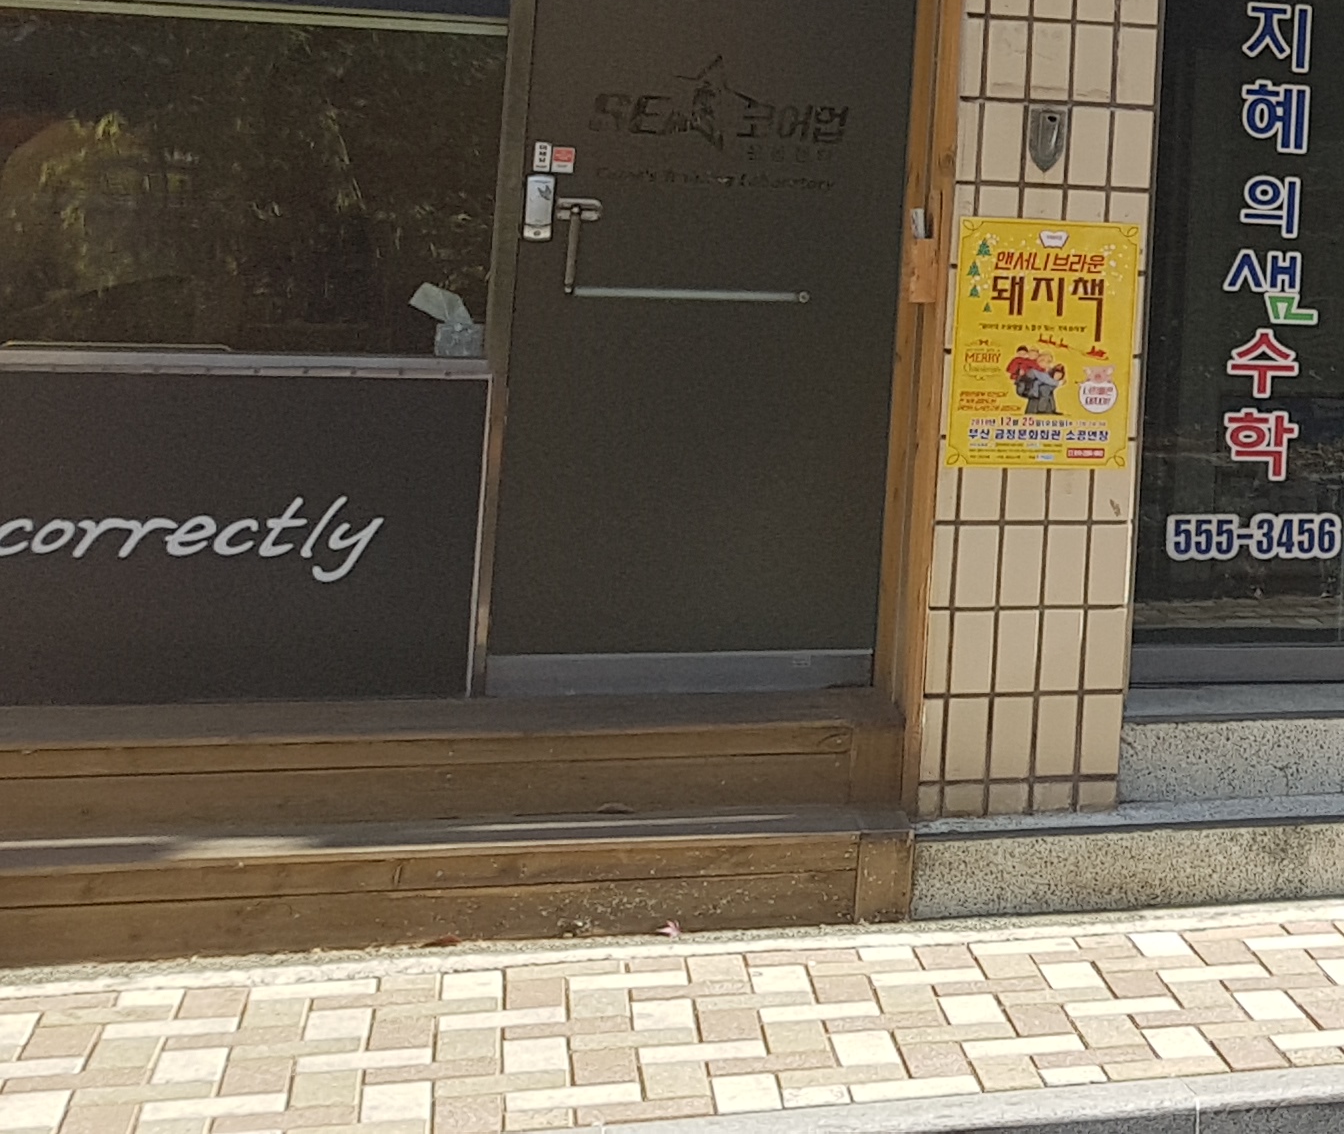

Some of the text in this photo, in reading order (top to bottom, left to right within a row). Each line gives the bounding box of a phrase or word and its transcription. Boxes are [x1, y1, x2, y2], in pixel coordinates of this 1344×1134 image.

[1051, 252, 1106, 274] 브라운
[990, 275, 1105, 342] 돼지책
[0, 495, 385, 584] correctly
[1168, 513, 1341, 560] 555-3456
